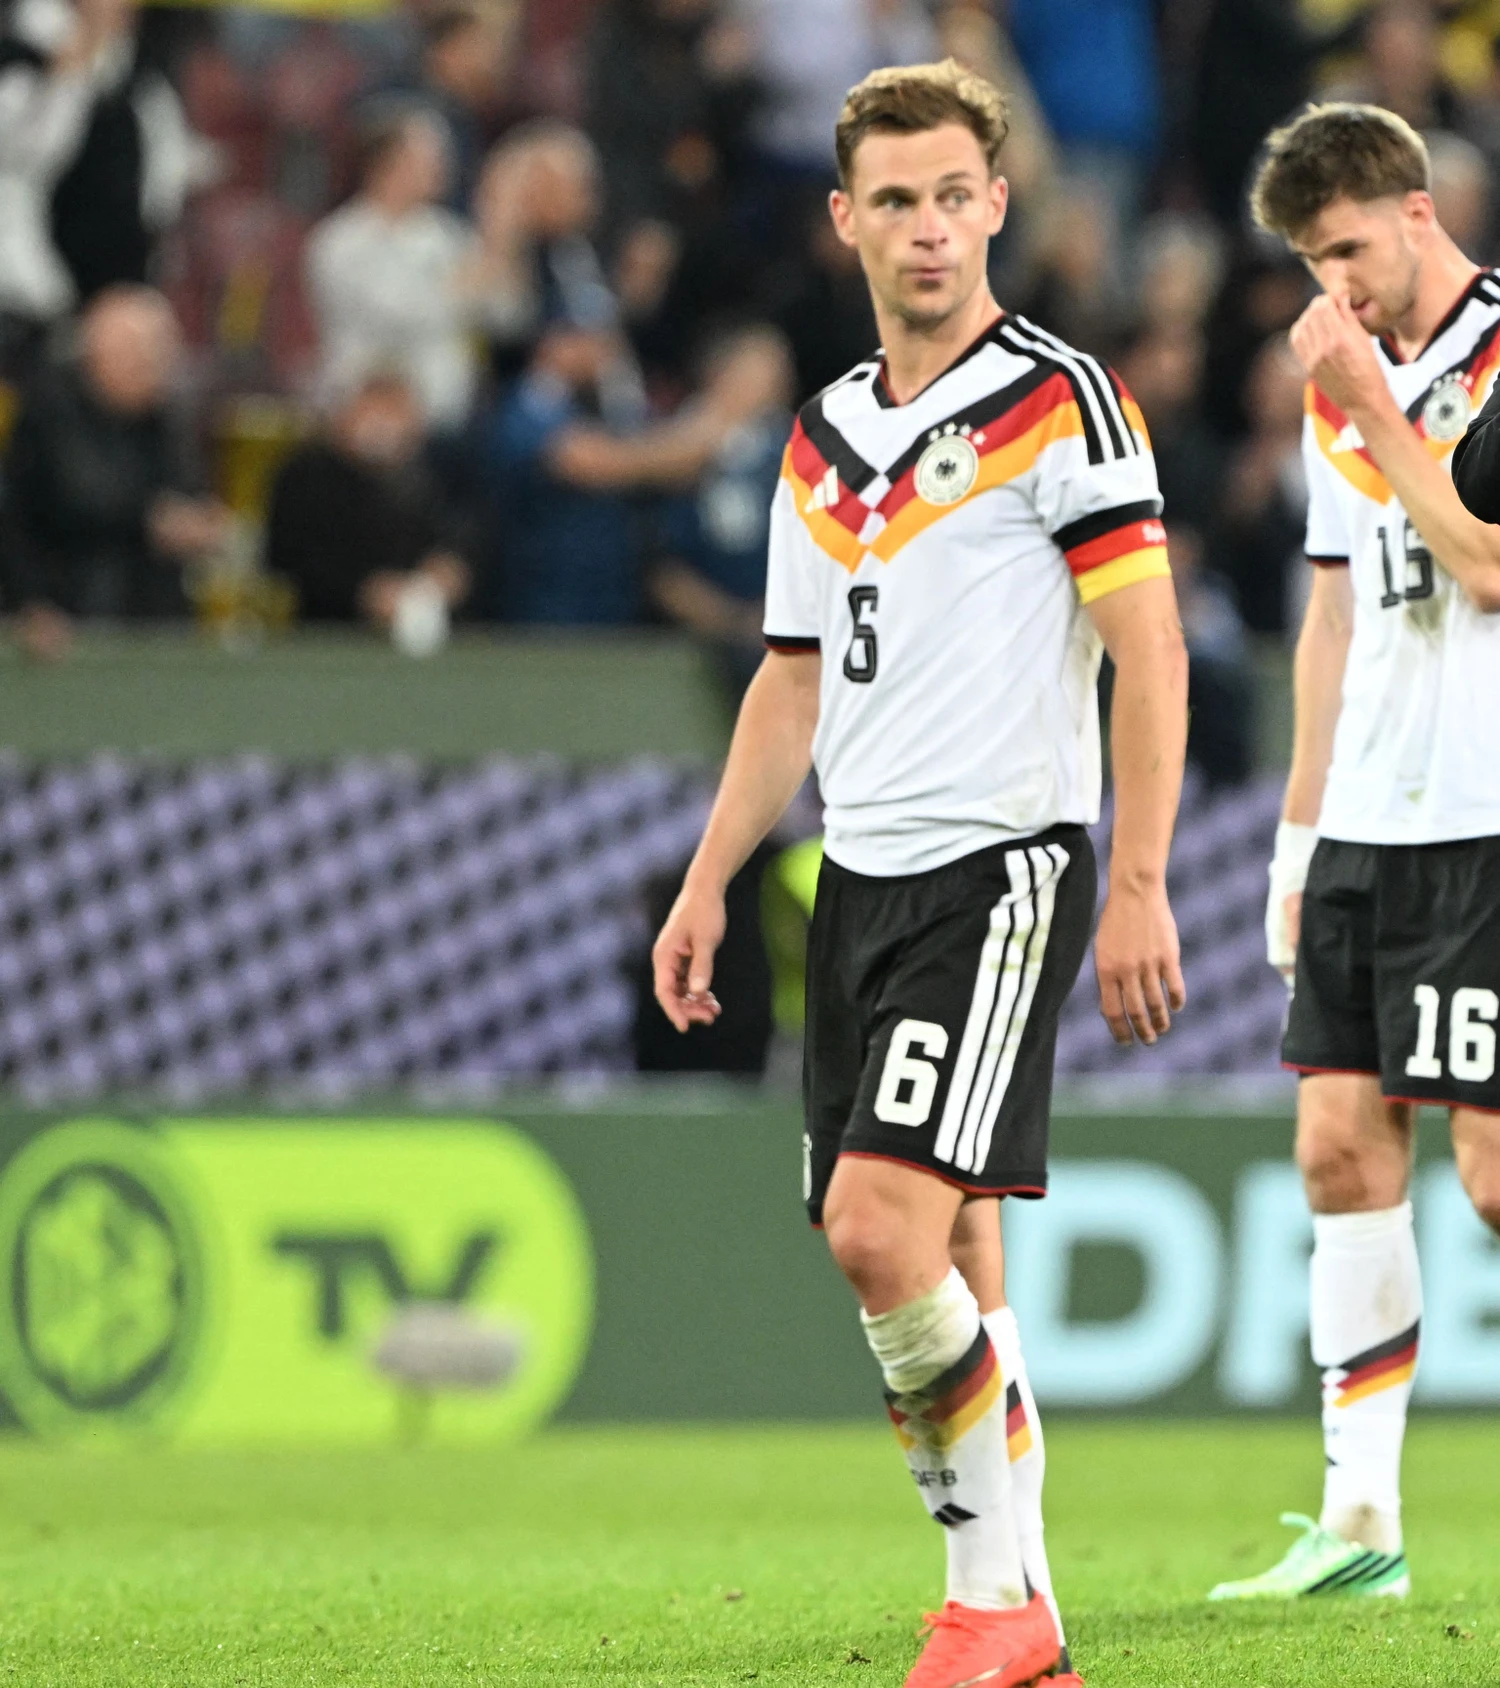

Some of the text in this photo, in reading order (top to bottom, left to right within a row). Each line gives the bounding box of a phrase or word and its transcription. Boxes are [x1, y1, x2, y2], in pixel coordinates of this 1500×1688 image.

[842, 585, 879, 684] 6
[874, 1018, 949, 1127] 6
[1405, 984, 1499, 1082] 16
[270, 1230, 500, 1344] TV
